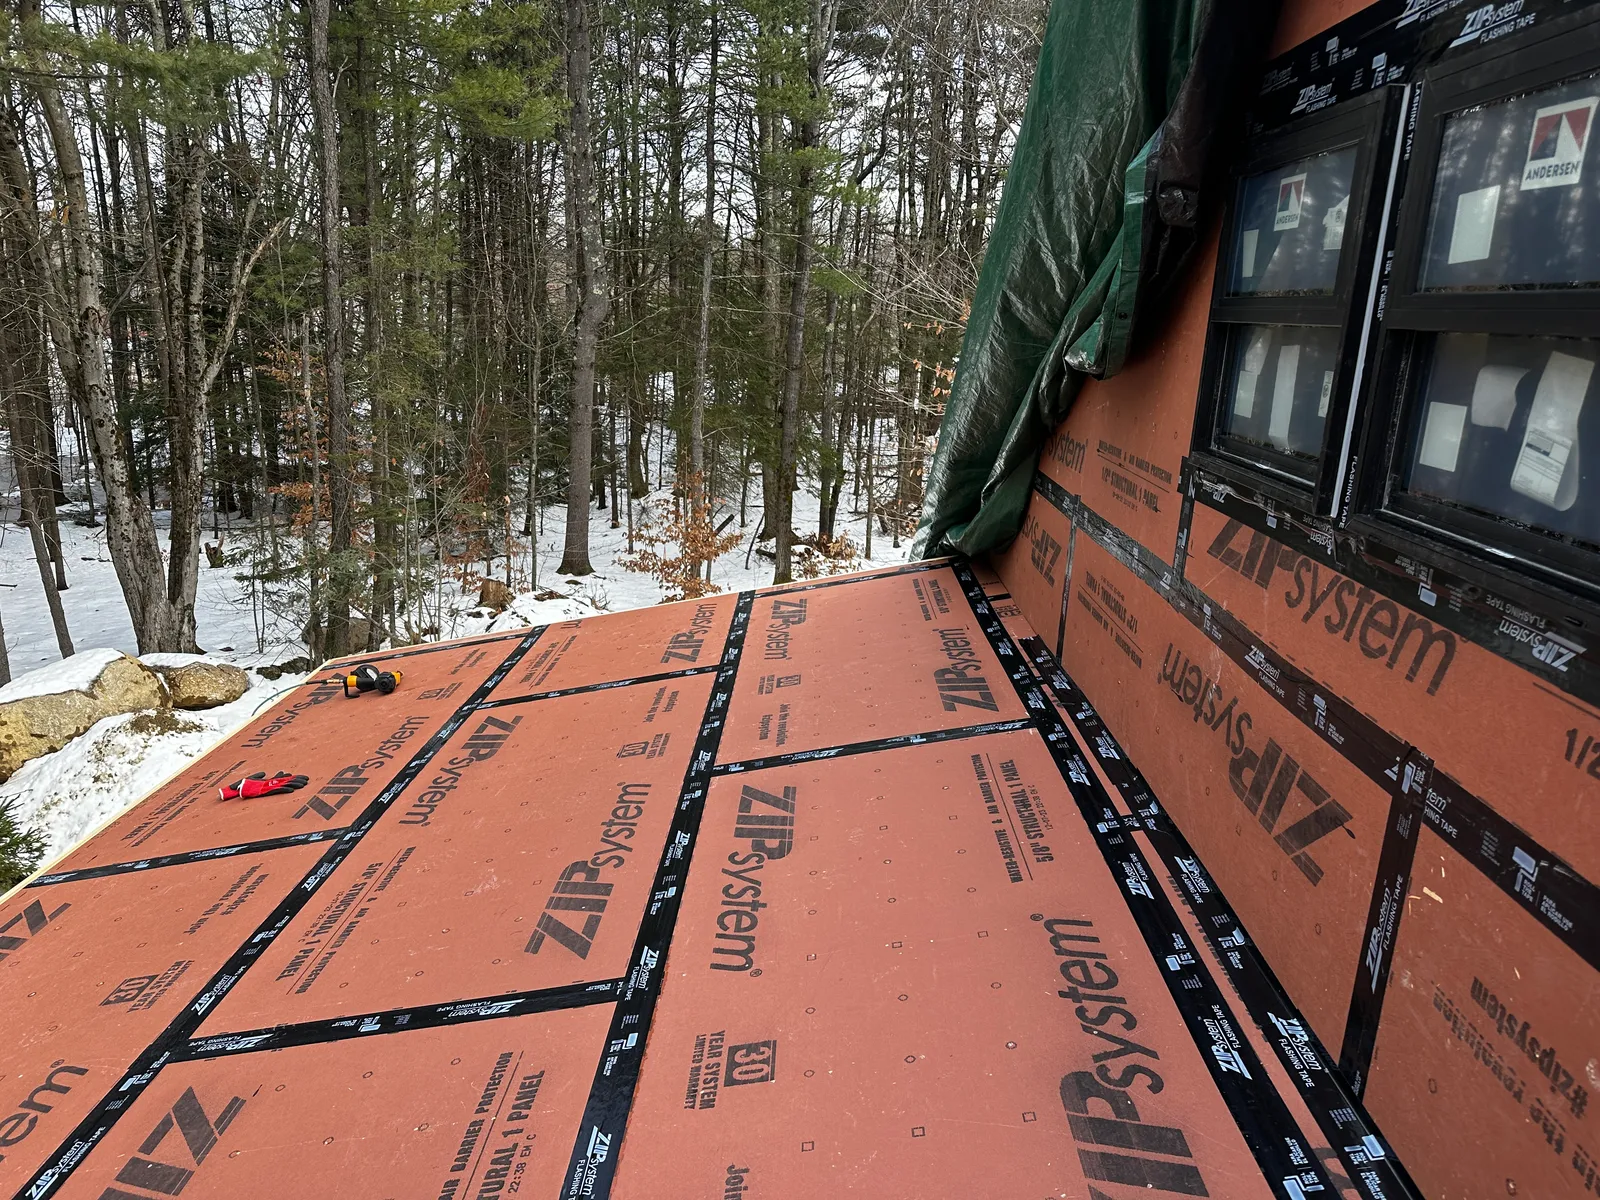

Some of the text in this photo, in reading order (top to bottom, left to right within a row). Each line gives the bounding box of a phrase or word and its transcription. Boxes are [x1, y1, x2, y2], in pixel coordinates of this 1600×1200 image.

[1480, 13, 1536, 43] FLASHING TAPE
[1296, 82, 1333, 106] ZIPsystem
[1306, 101, 1326, 113] FLASHING
[1404, 131, 1413, 161] TAPE
[1525, 160, 1580, 180] ANDERSEN
[1276, 212, 1299, 225] ANDERSEN
[1048, 431, 1087, 474] system
[1339, 456, 1357, 528] FLASHING TAPE
[1487, 594, 1545, 628] FLASHING TAPE
[660, 603, 717, 663] ZIPsystem
[764, 598, 807, 660] ZIPsystem
[1500, 619, 1578, 672] ZIPsystem
[934, 628, 999, 712] ZIPsystem
[1246, 645, 1280, 679] ZIPsystem
[1259, 671, 1277, 690] FLASHING
[1276, 686, 1285, 698] TAPE
[291, 717, 430, 820] ZIPsystem
[399, 715, 523, 826] ZIPsystem
[1000, 759, 1021, 782] PANEL
[1067, 760, 1086, 783] ZIPsystem
[1162, 642, 1353, 887] ZIPsystem
[1010, 788, 1044, 840] STRUCTURAL
[1425, 807, 1458, 838] HING TAPE
[674, 831, 690, 859] ZIPsystem
[995, 828, 1023, 883] WATER-RESISTIVE
[1030, 842, 1054, 863] 5/8"
[362, 862, 383, 880] 5/8"
[524, 783, 652, 960] ZIPsystem
[710, 785, 797, 972] ZIPsystem
[1122, 863, 1146, 896] ZIPsystem
[1130, 853, 1148, 883] FLASHING TAPE
[1182, 856, 1212, 892] ZIPsystem
[1181, 874, 1203, 903] FLASHING TAPE
[311, 881, 367, 937] STRUCTURAL
[1383, 874, 1404, 950] FLASHING TAPE
[1366, 886, 1392, 976] ZIPsystem
[150, 960, 186, 991] SYSTEM
[275, 948, 315, 981] PANEL
[295, 951, 336, 994] PROTECTION
[639, 949, 659, 990] ZIPsystem
[191, 974, 230, 1013] ZIPsystem
[625, 966, 639, 1000] FLASHING TAPE
[449, 1000, 518, 1017] ZIPsystem
[456, 1000, 490, 1009] FLASHING
[1212, 1005, 1241, 1052] FLASHING TAPE
[1278, 1018, 1321, 1069] ZIPsystem
[1204, 1019, 1241, 1073] ZIPsystem
[1279, 1039, 1315, 1087] FLASHING TAPE
[1470, 976, 1589, 1119] #zipsystem
[684, 1034, 706, 1109] LIMITED WARRANTY
[698, 1030, 725, 1110] YEAR SYSTEM
[732, 1046, 772, 1081] 30
[450, 1119, 485, 1172] BARRIER
[474, 1052, 514, 1115] PROTECTION
[62, 1126, 106, 1173] FLASHING TAPE
[476, 1070, 545, 1200] TURAL 1 PANEL
[1285, 1138, 1303, 1164] APLICAR USE
[1291, 1139, 1304, 1158] RODILLO
[25, 1140, 83, 1199] ZIPsystem
[582, 1132, 611, 1198] ZIPsystem
[1290, 1151, 1299, 1165] PARA
[1349, 1154, 1359, 1164] TAPE
[1353, 1153, 1363, 1161] THE
[1357, 1152, 1368, 1163] ROLL
[507, 1162, 526, 1194] 22:38
[570, 1160, 585, 1195] FLASHING
[1301, 1173, 1310, 1184] ROLL
[1306, 1175, 1315, 1183] THE
[1310, 1172, 1319, 1183] TAPE
[1364, 1172, 1380, 1193] APLICAR
[1364, 1179, 1381, 1199] RODILLO
[1370, 1172, 1381, 1184] PARA
